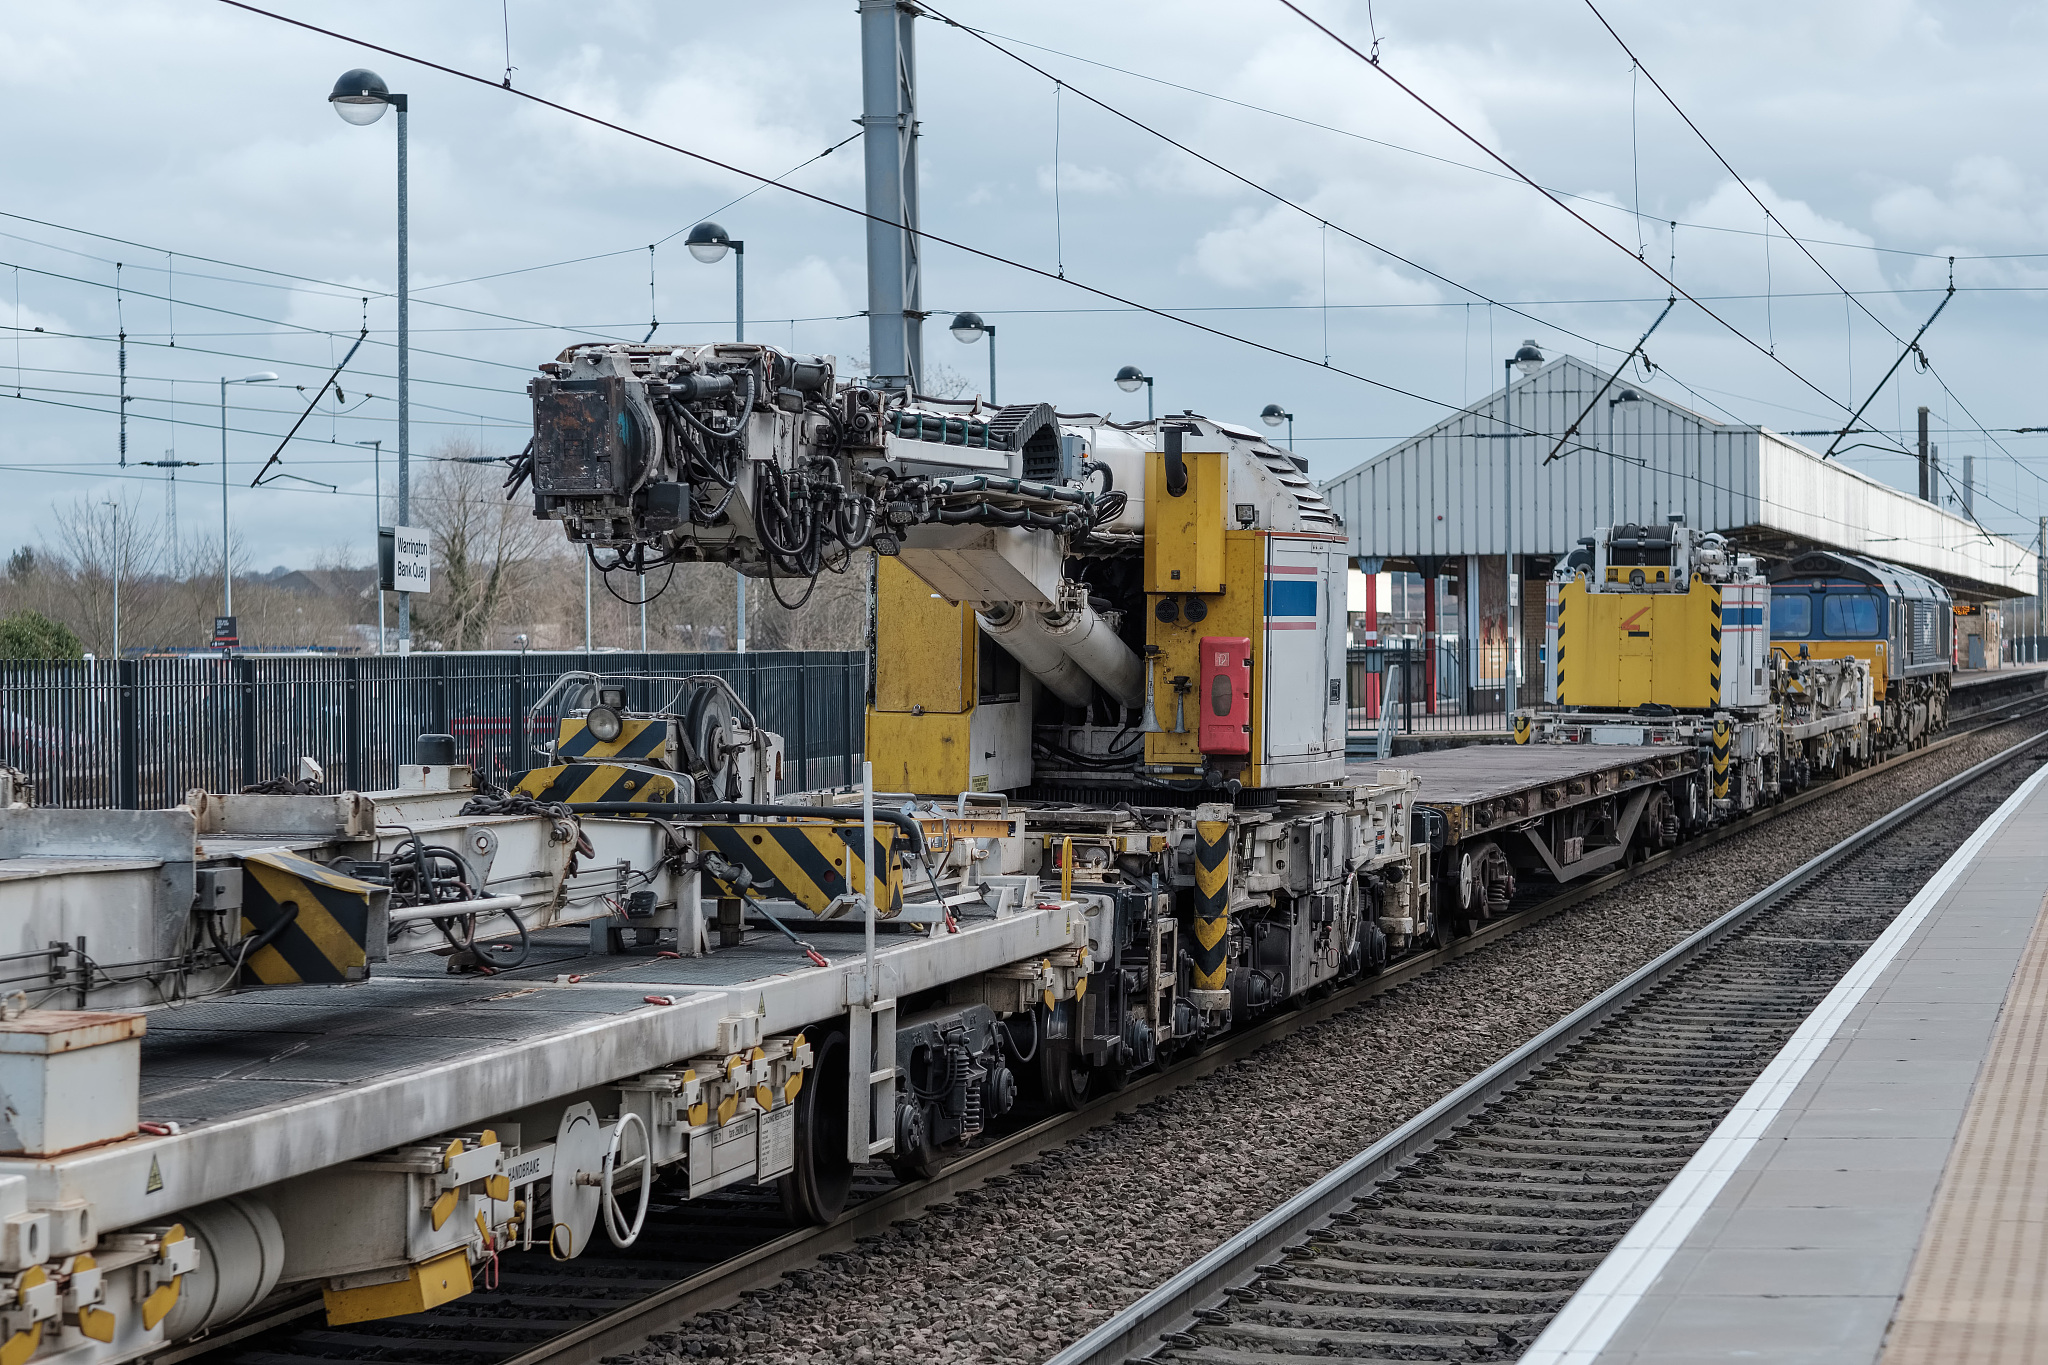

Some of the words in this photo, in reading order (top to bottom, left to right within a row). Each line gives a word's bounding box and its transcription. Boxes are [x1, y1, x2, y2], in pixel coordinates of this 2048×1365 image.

[398, 537, 428, 558] Warrington
[398, 561, 412, 577] Bank
[413, 562, 427, 582] Quay
[508, 1157, 540, 1182] HANDBRAKE
